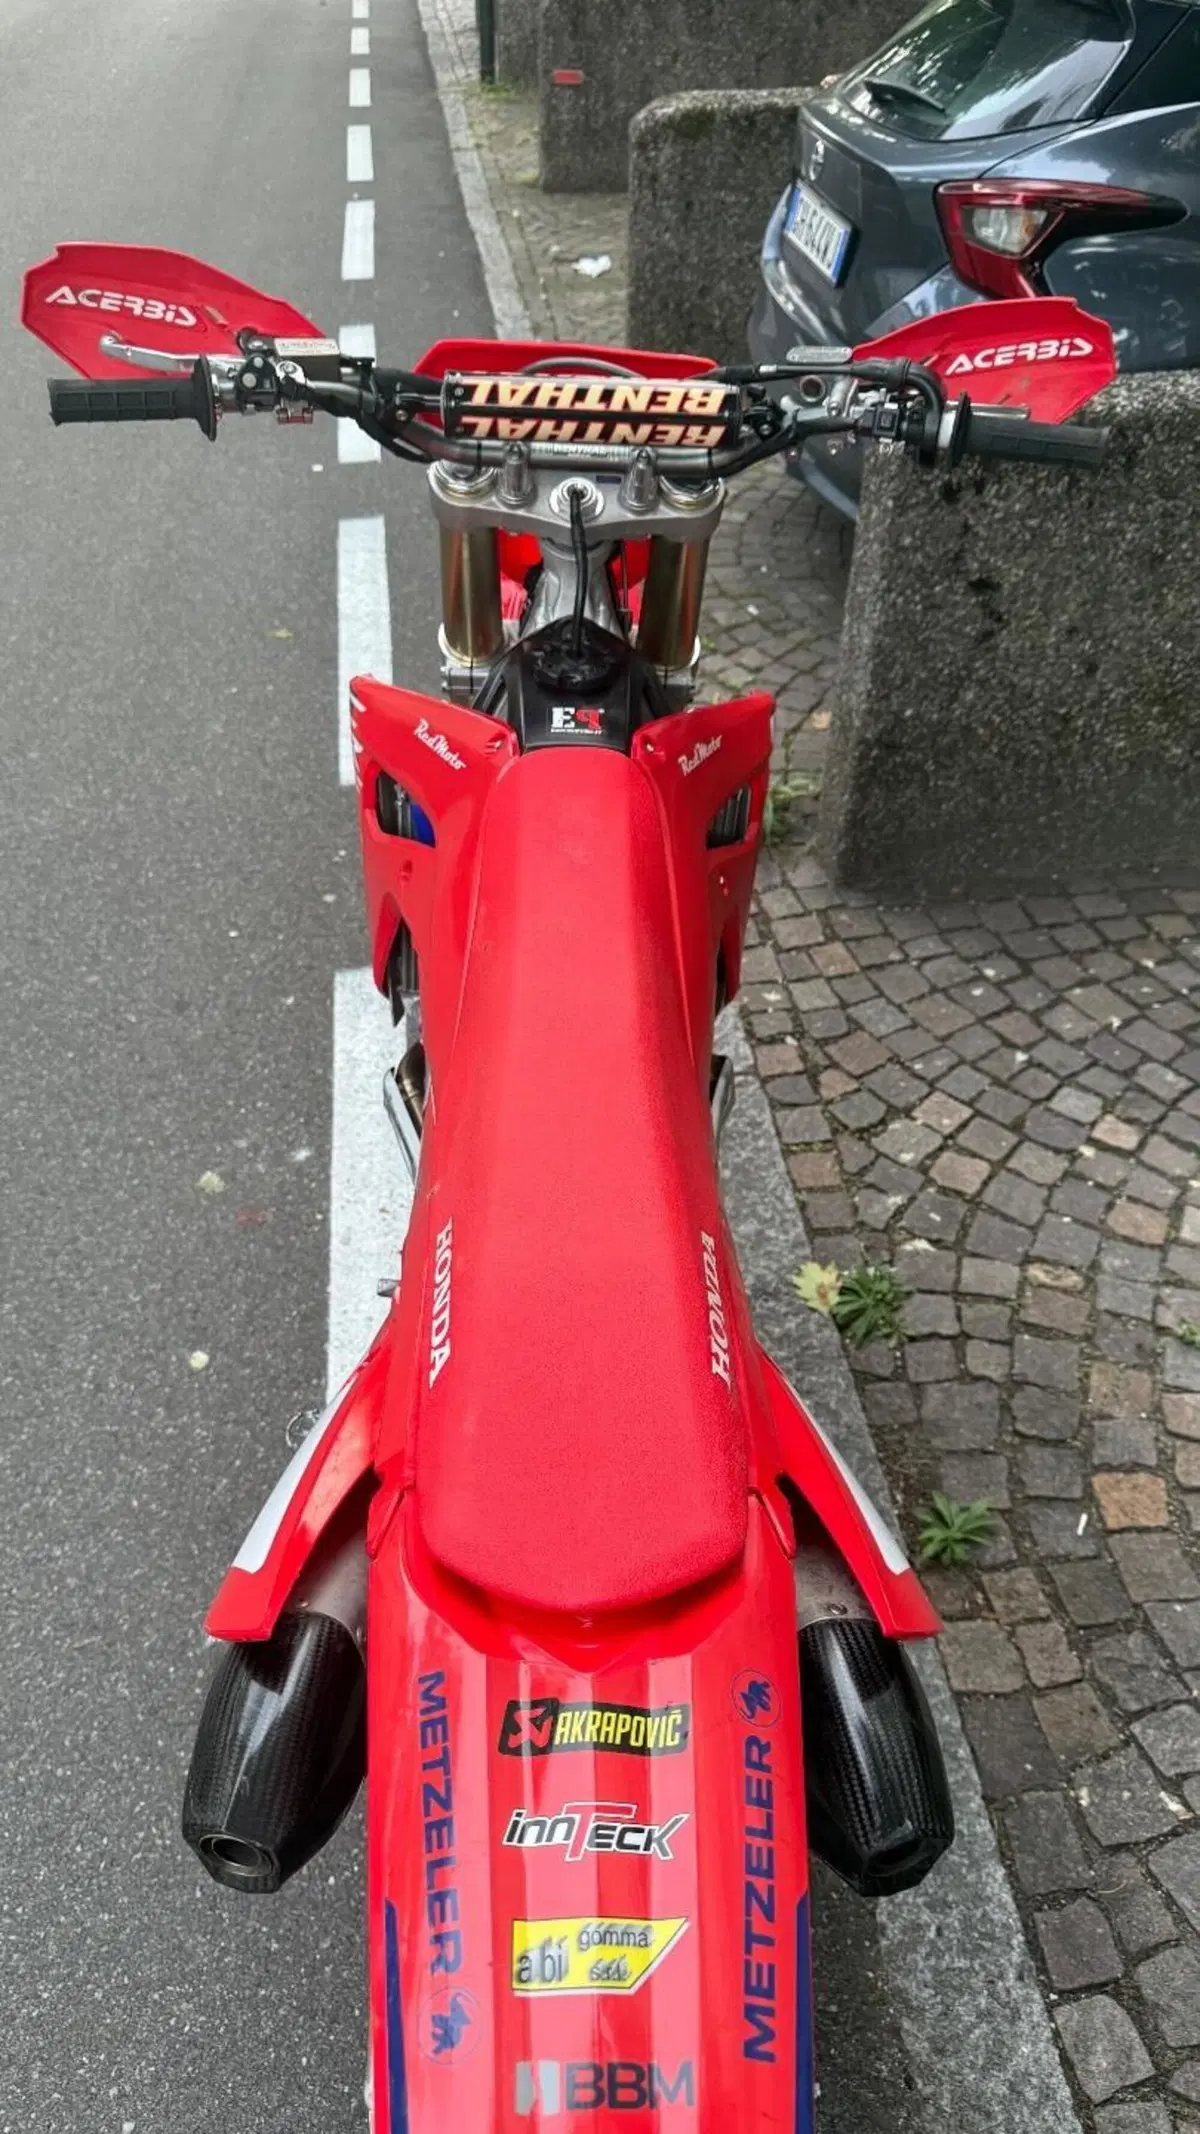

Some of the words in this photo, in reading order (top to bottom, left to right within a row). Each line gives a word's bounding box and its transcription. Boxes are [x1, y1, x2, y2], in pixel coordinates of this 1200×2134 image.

[45, 286, 197, 326] ACERBiS
[945, 338, 1094, 375] ACERBiS
[460, 380, 726, 414] RENTHAL
[460, 415, 727, 448] RENTHAL
[429, 1216, 452, 1390] HONDA
[701, 1230, 731, 1389] HONDA
[418, 1670, 463, 1977] METZELER
[743, 1734, 777, 2063] METZELER
[578, 1924, 652, 1952] gomma
[564, 2060, 695, 2110] BBM
